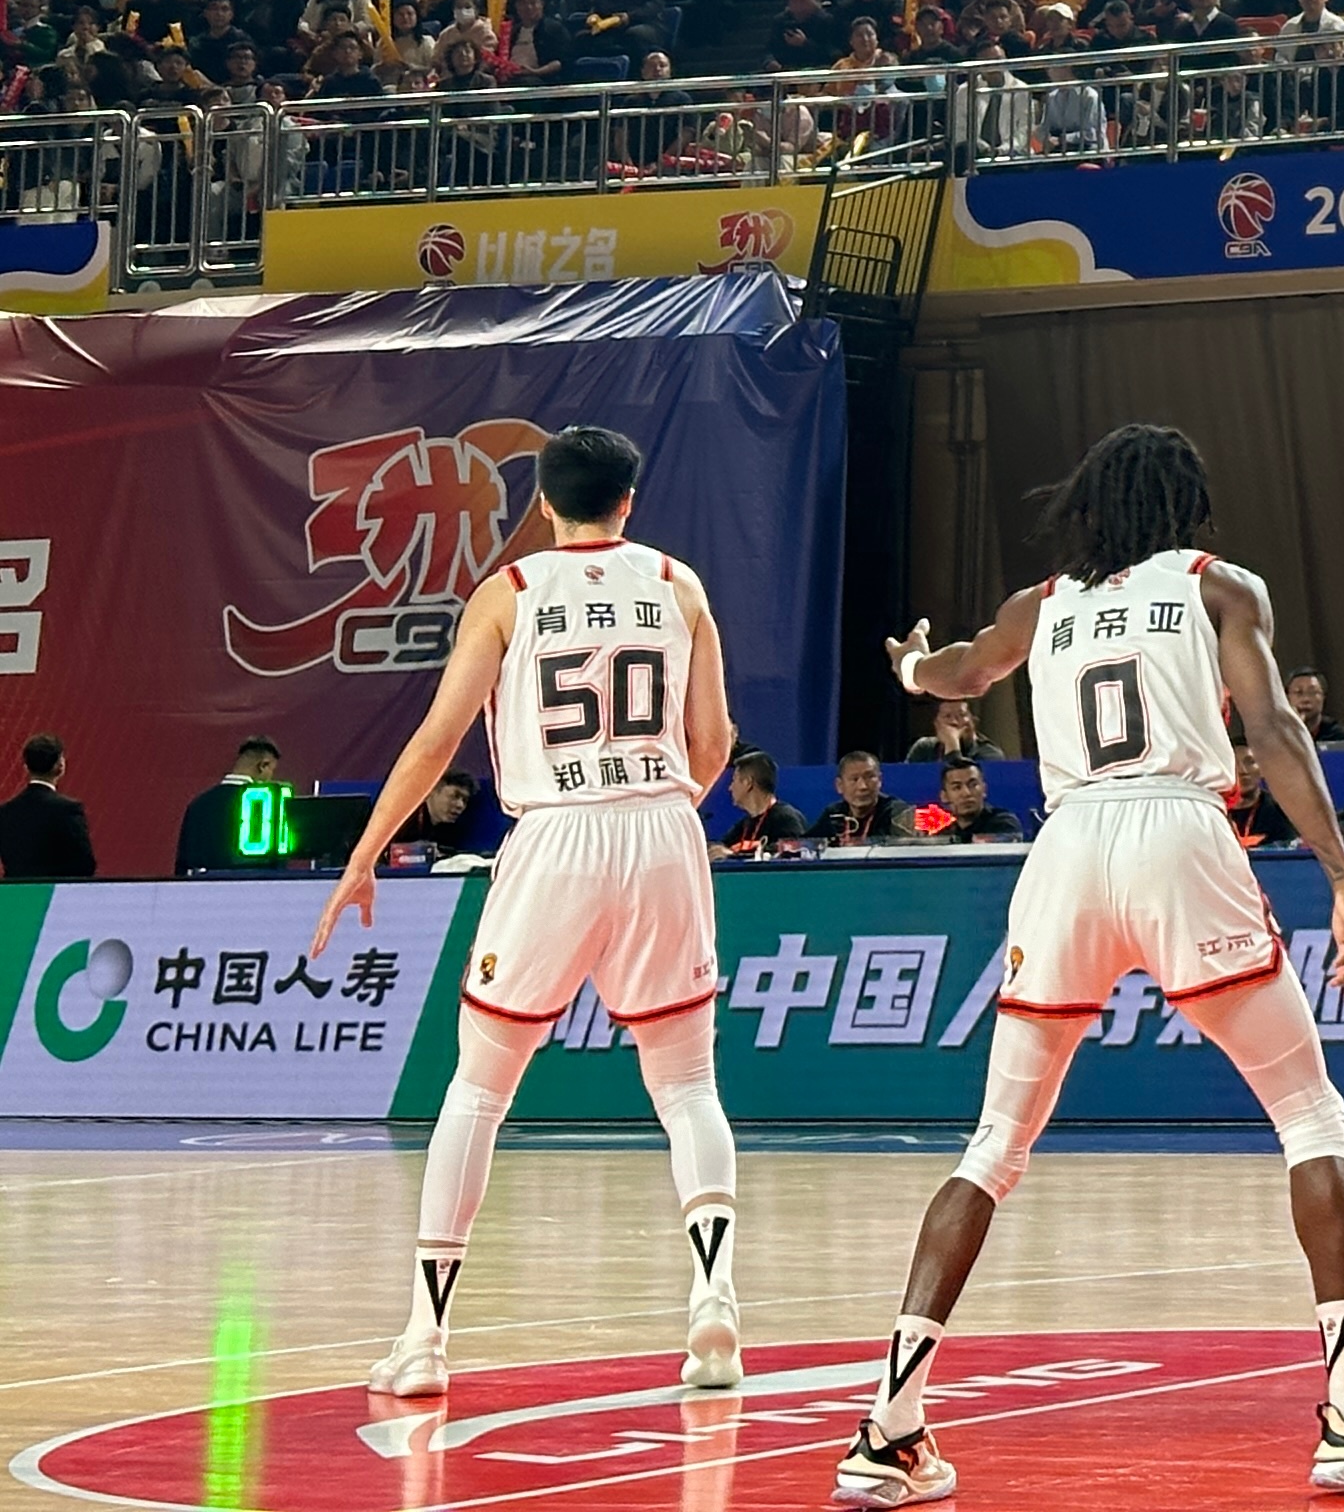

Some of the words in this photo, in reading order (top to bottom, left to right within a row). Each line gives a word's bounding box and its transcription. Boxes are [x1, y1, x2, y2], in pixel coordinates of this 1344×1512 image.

[535, 600, 663, 636] 肯帝亚
[1051, 601, 1185, 656] 肯帝亚
[535, 644, 669, 750] 50
[1075, 651, 1151, 777] 0
[153, 947, 401, 1010] 中国人寿
[146, 1020, 278, 1055] CHINA
[293, 1020, 388, 1053] LIFE
